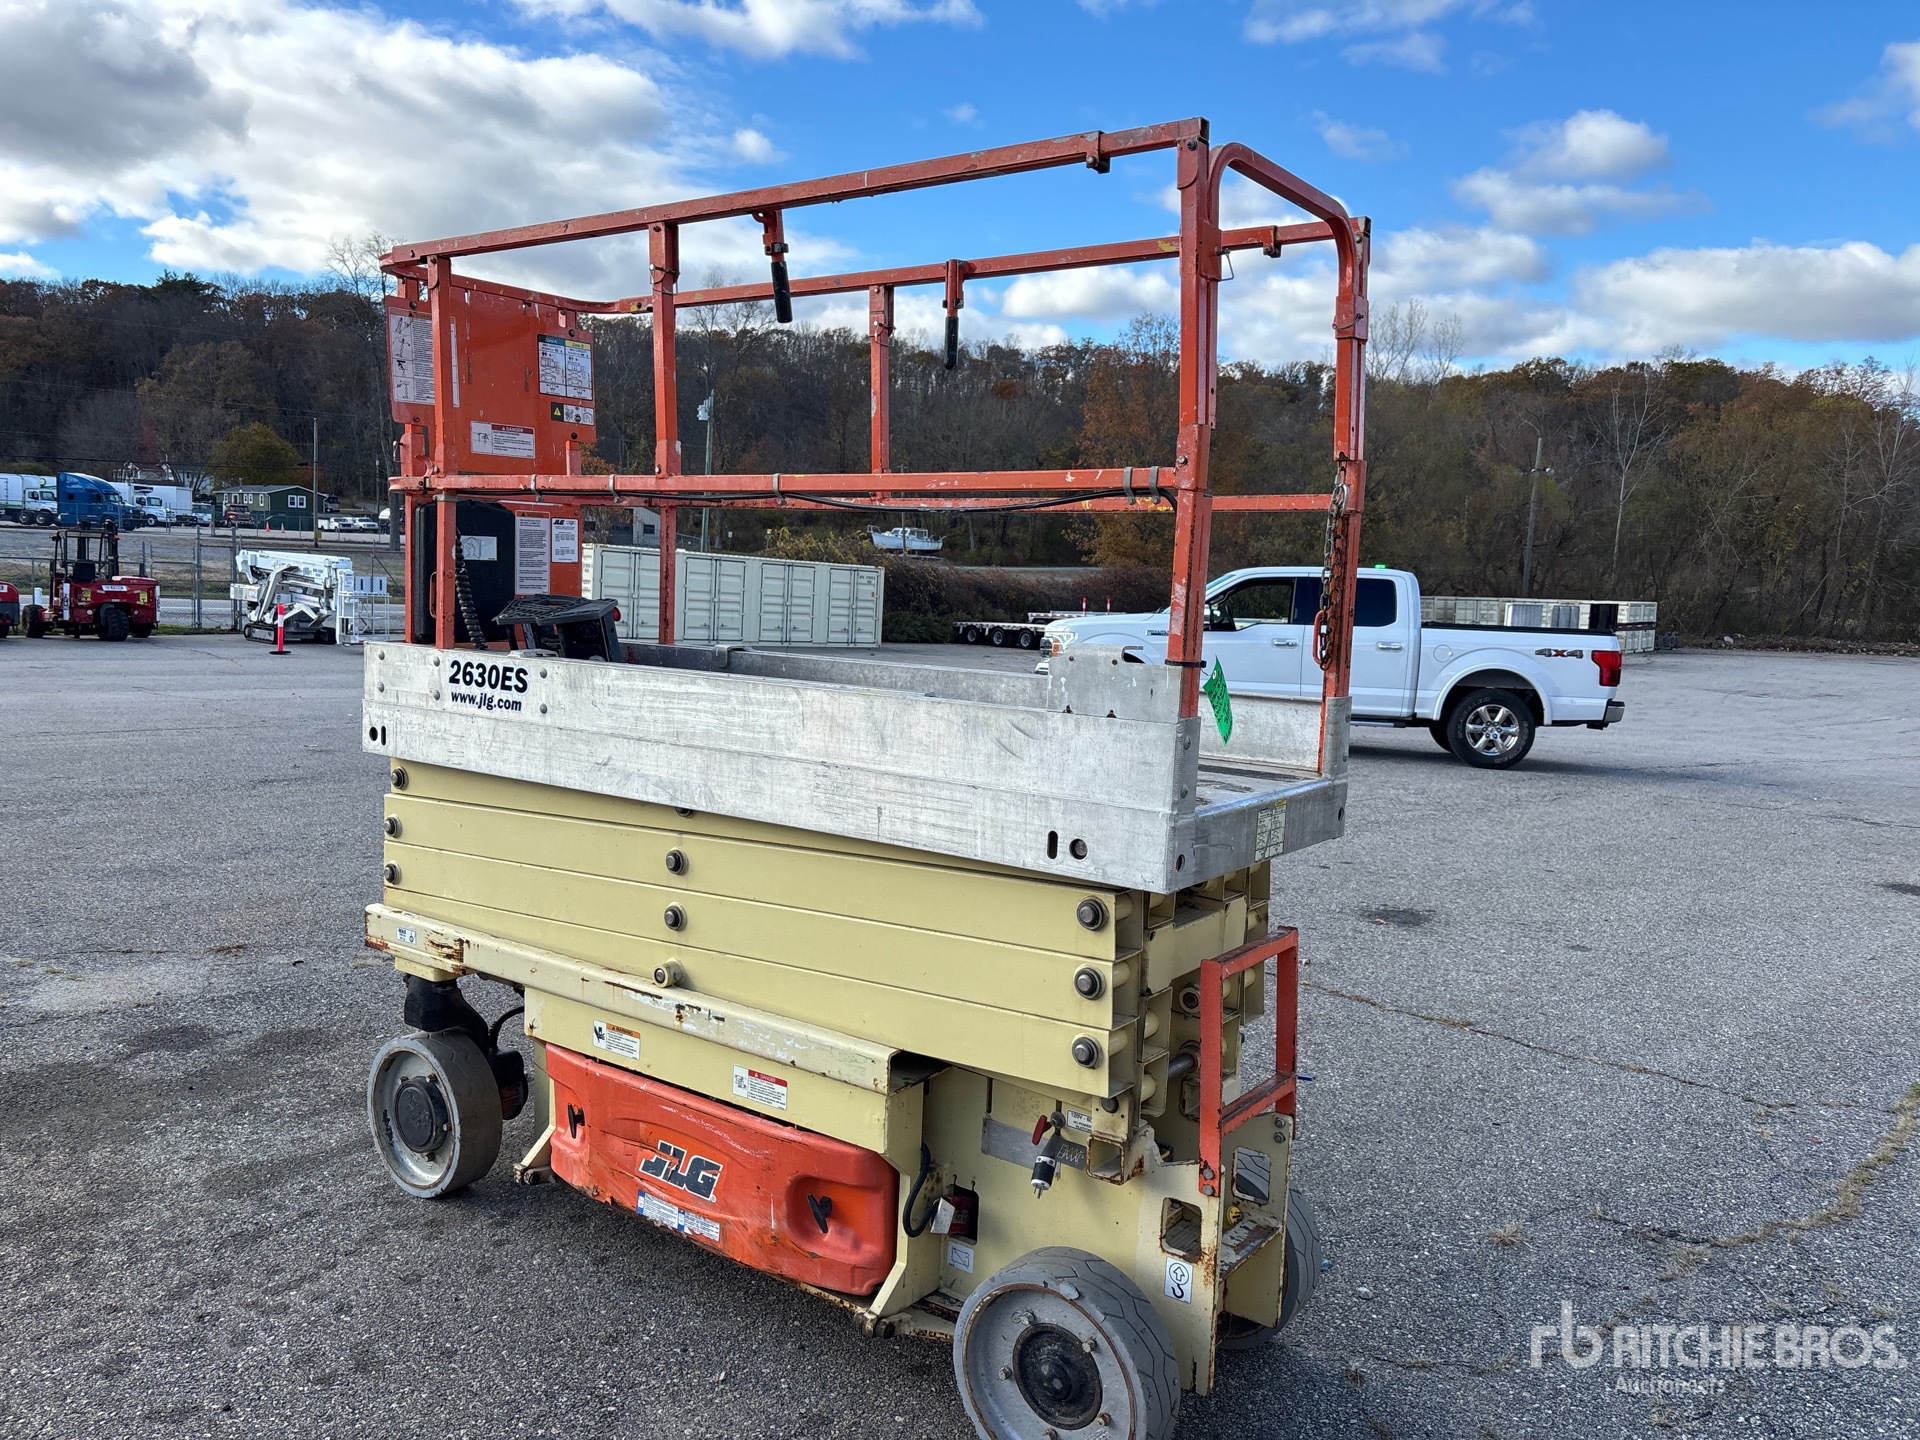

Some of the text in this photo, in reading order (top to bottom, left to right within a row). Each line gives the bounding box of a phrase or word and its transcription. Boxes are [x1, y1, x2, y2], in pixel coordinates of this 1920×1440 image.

[449, 660, 528, 693] 2630ES
[451, 692, 522, 711] www.jlg.com
[614, 1025, 634, 1036] WARNING
[759, 1073, 776, 1083] DANGER
[638, 1139, 724, 1202] JLG
